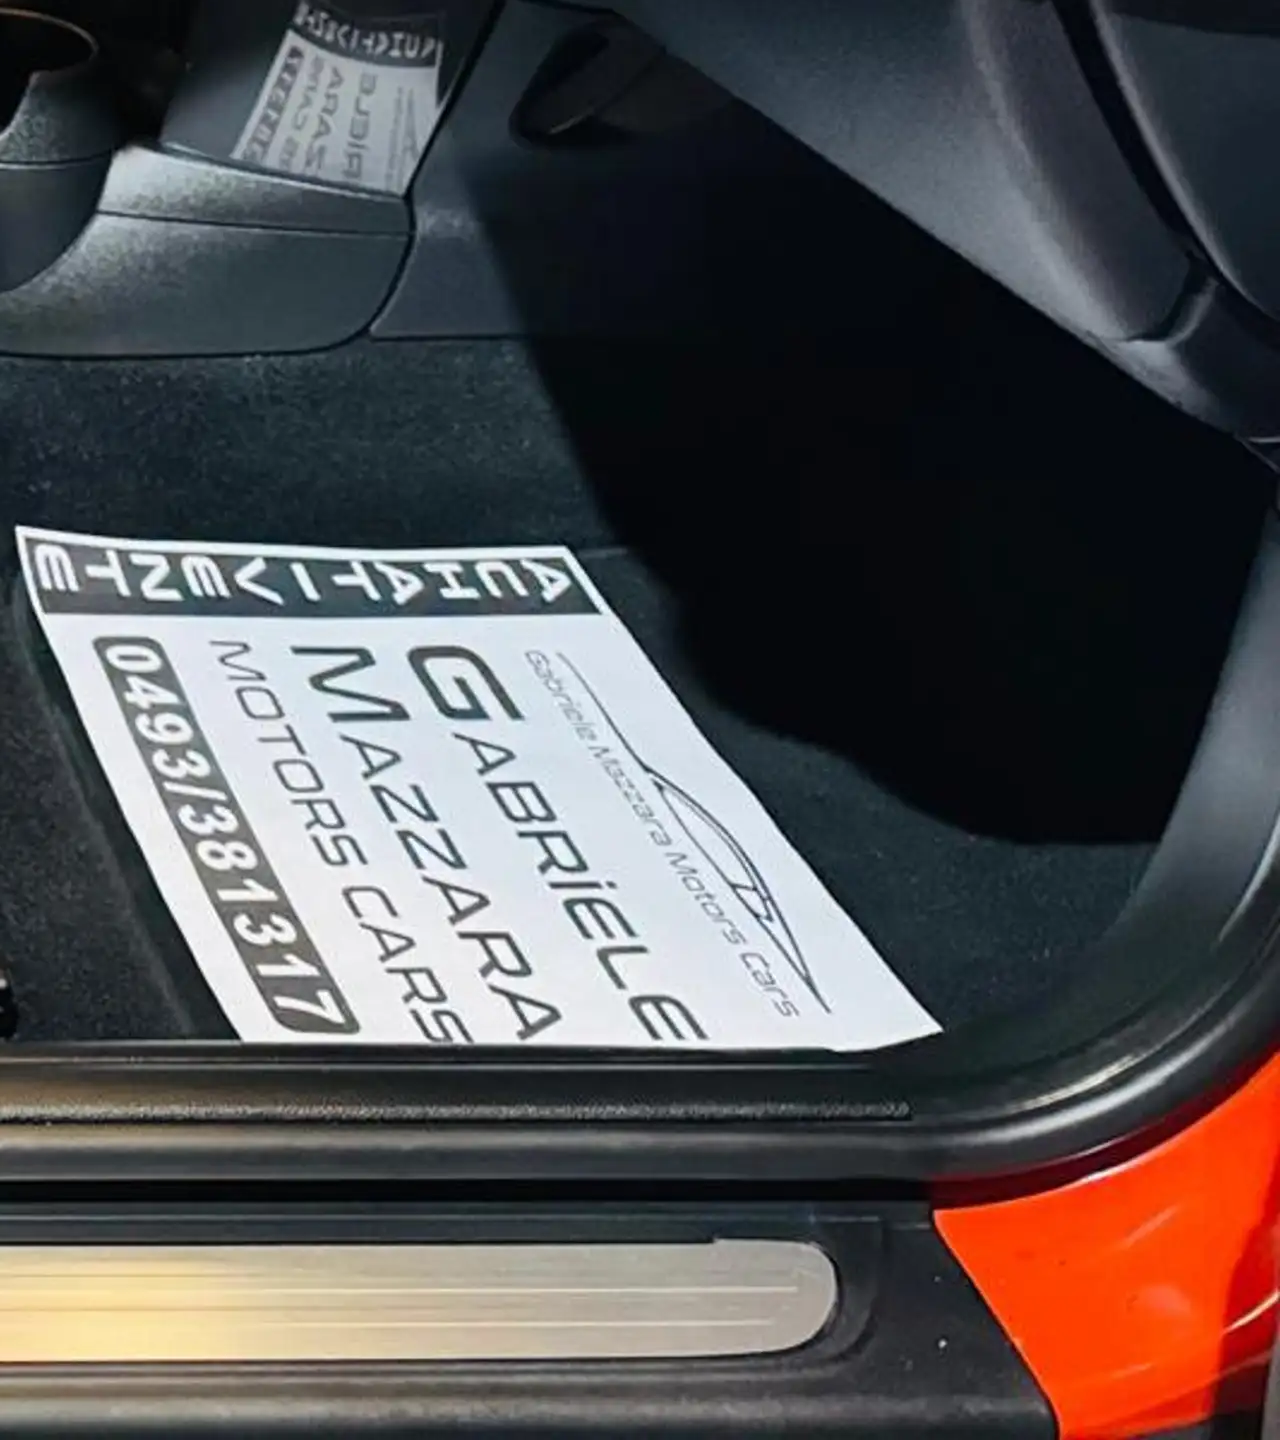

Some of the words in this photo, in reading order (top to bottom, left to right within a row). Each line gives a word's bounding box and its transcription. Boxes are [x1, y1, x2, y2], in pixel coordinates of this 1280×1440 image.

[100, 644, 349, 1030] 0493/381317
[210, 638, 369, 868] MOTORS
[343, 885, 474, 1044] CARS
[523, 650, 598, 743] Gabriele
[587, 745, 670, 852] Mazzara
[663, 851, 746, 942] Motors
[728, 929, 799, 1020] Cars
